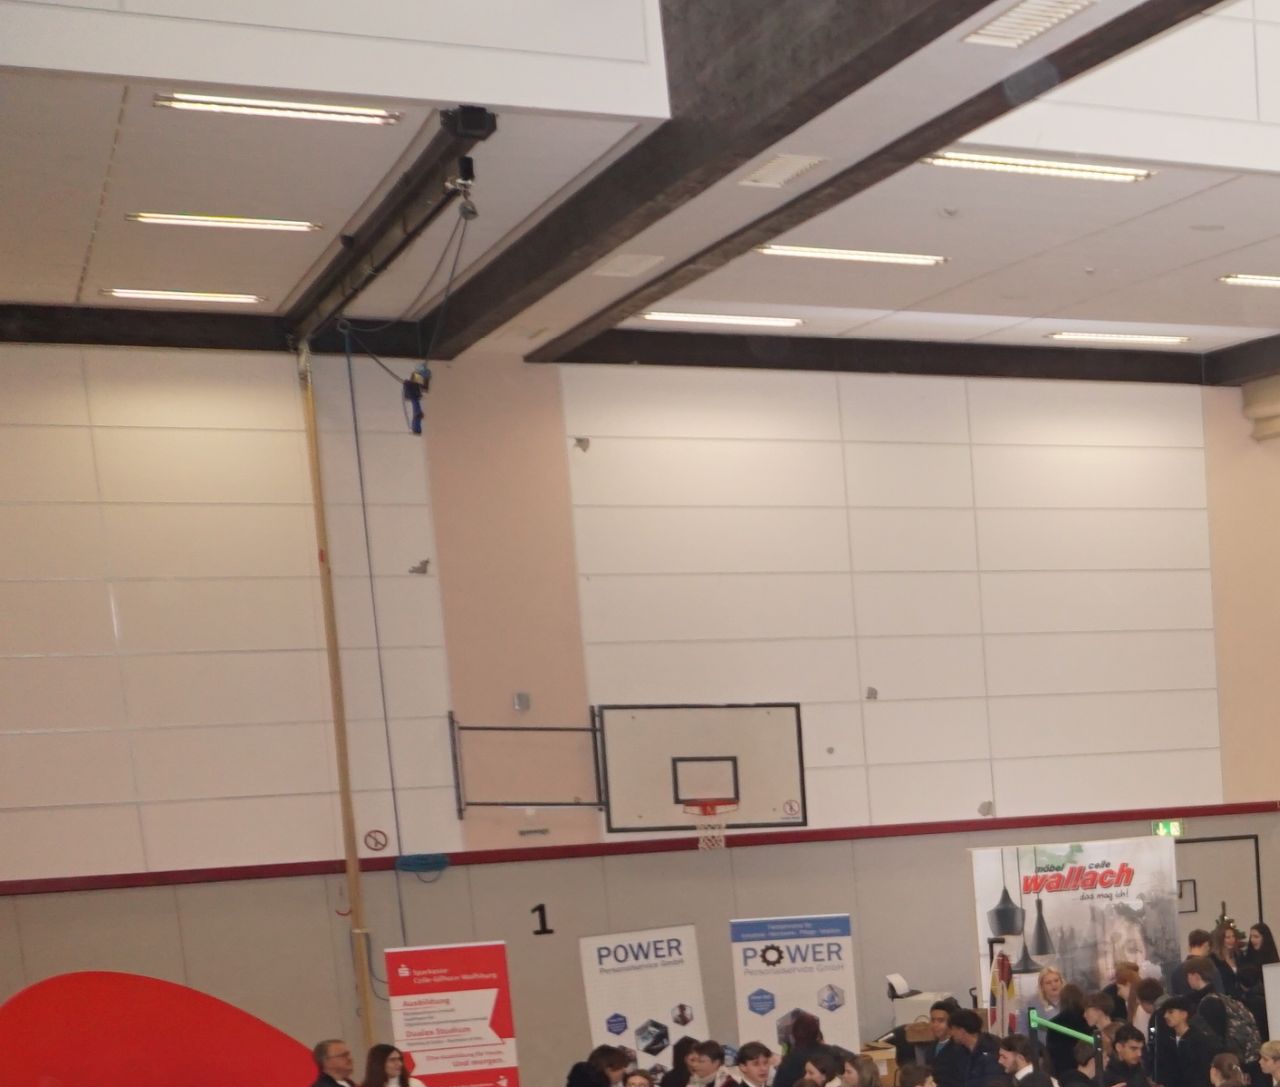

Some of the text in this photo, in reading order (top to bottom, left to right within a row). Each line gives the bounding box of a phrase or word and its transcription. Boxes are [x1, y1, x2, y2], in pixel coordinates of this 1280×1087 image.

[1022, 862, 1135, 895] wallach
[530, 903, 555, 936] 1
[596, 938, 683, 966] POWER
